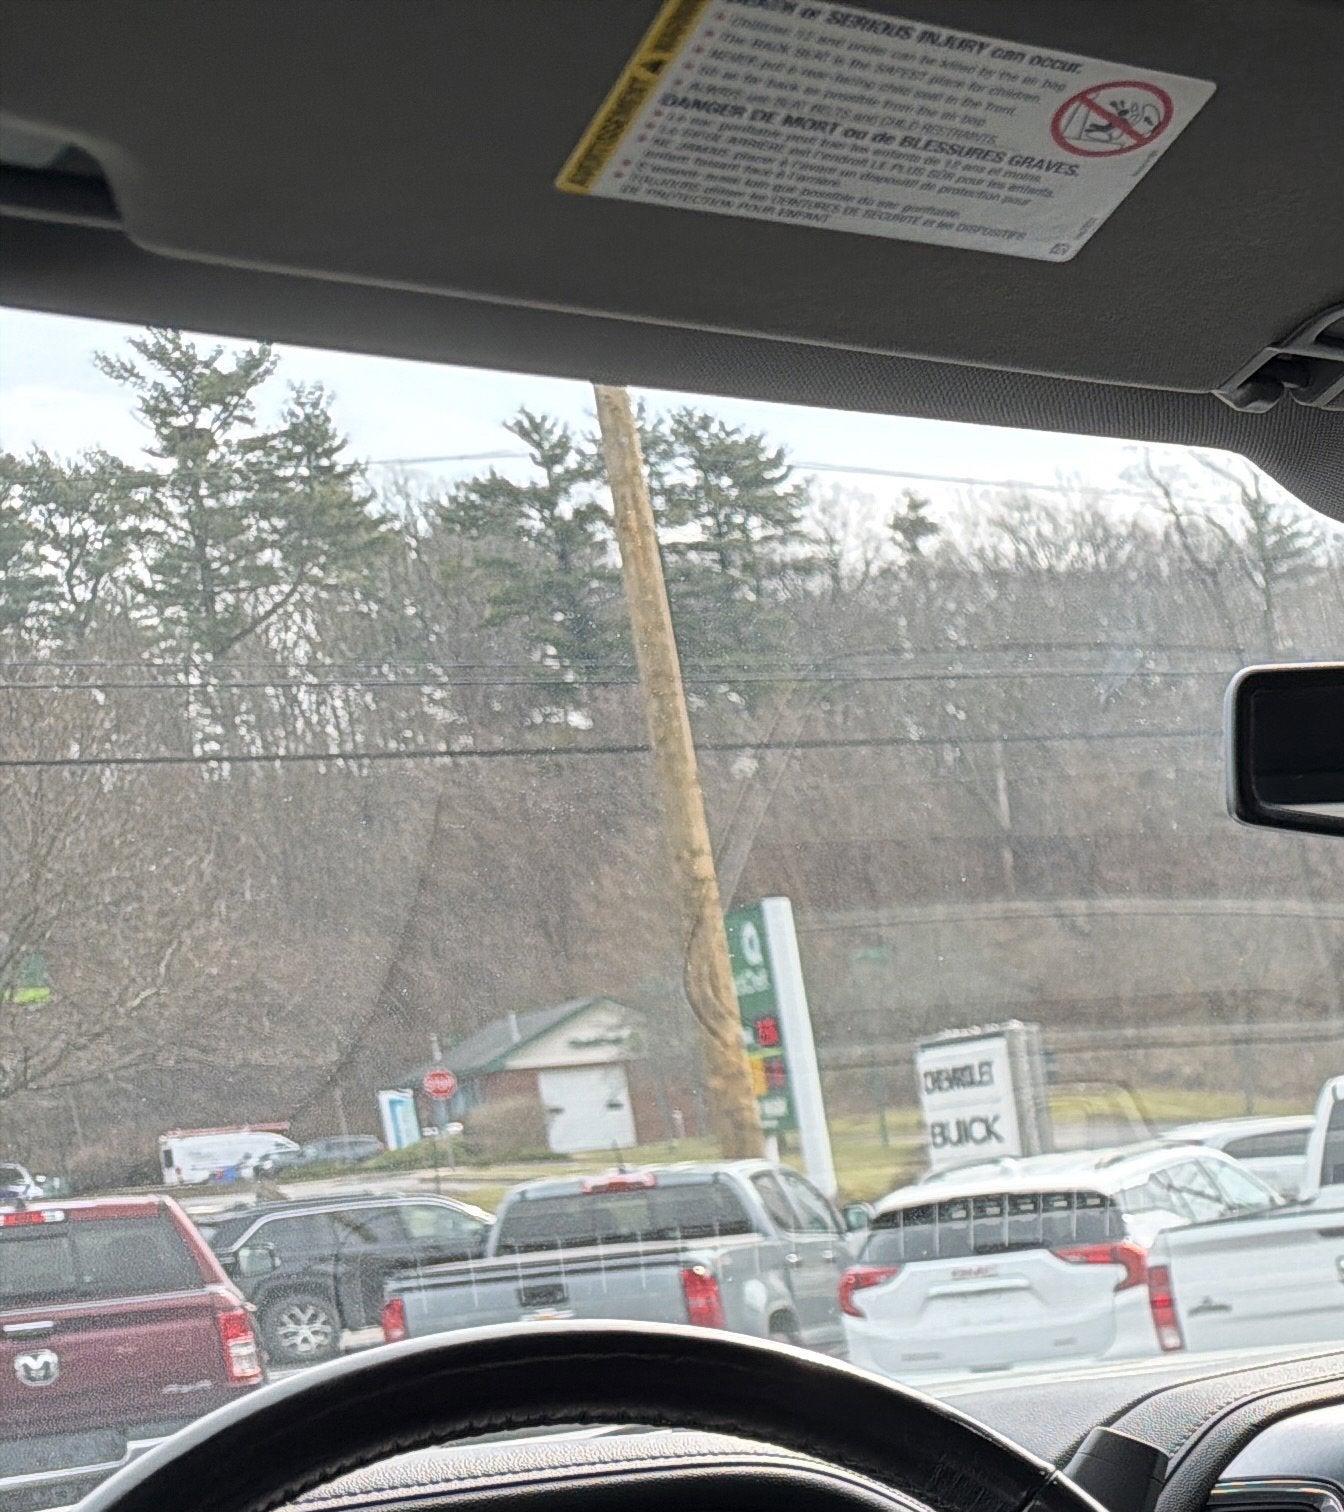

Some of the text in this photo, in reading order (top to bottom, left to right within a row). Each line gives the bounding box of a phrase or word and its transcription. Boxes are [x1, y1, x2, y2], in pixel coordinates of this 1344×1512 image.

[824, 13, 914, 39] SERIOUS
[916, 30, 986, 53] INJURY
[992, 45, 1026, 61] can
[1030, 53, 1085, 72] occur.
[660, 94, 744, 117] DANGER
[748, 109, 776, 123] DE
[782, 115, 838, 133] MORT
[841, 125, 868, 139] ou
[872, 131, 897, 144] de
[900, 136, 1005, 161] BLESSURES
[1008, 155, 1083, 175] GRAVES.
[923, 1060, 995, 1096] CHEVROLET
[930, 1113, 1005, 1150] BUICK
